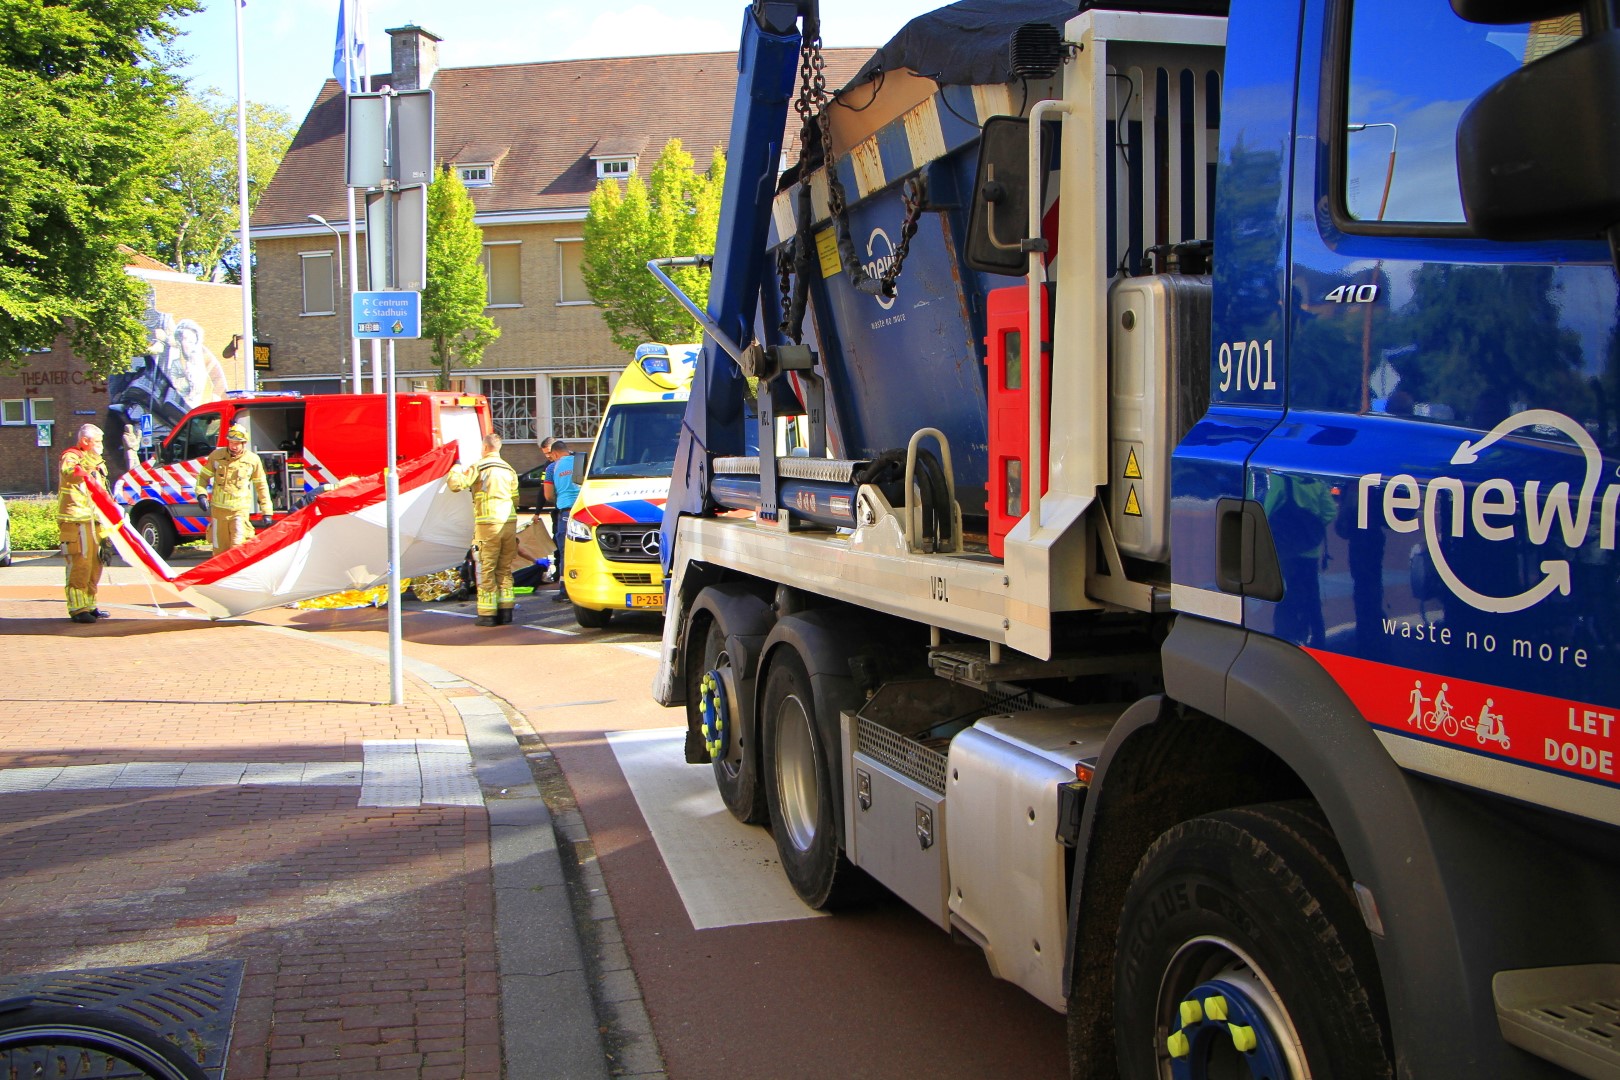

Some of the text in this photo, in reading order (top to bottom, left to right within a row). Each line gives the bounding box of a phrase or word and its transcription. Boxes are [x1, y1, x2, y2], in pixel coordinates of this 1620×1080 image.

[372, 298, 409, 307] Centrum
[1325, 284, 1379, 303] 410
[372, 308, 408, 317] Stadhuis
[22, 371, 68, 386] THEATER
[1218, 339, 1276, 392] 9701
[930, 575, 949, 603] VDL
[1382, 618, 1588, 668] waste no more
[1569, 707, 1615, 738] LET
[1544, 737, 1613, 775] DODE
